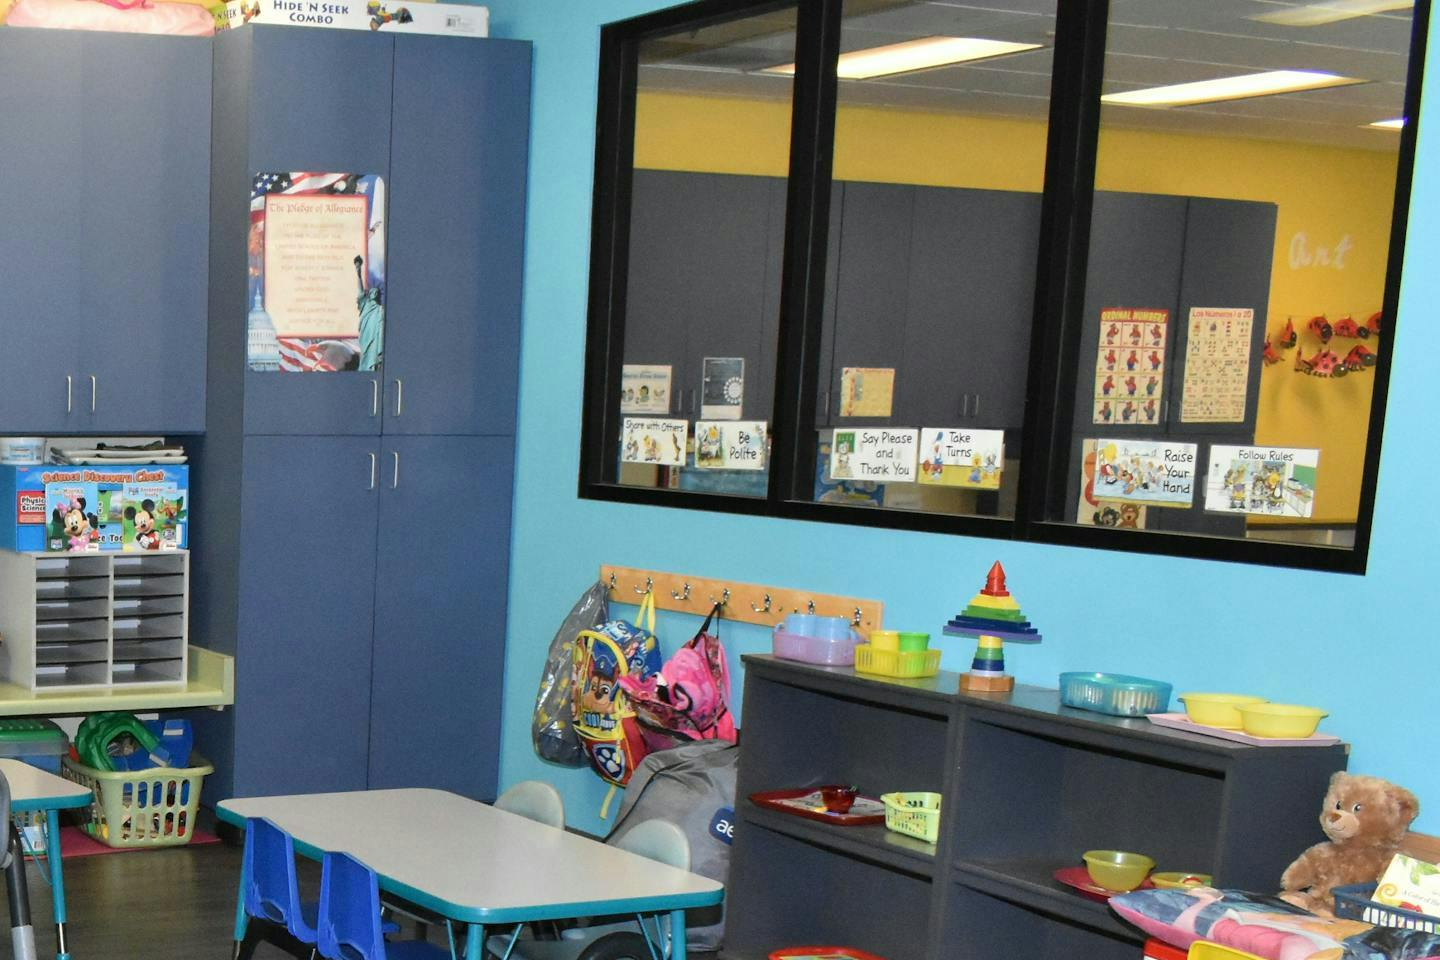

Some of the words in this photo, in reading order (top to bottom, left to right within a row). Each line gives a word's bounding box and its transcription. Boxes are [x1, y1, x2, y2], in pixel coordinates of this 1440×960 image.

[223, 7, 237, 19] SEEK
[273, 0, 303, 11] HIDE
[322, 3, 350, 14] SEEK
[289, 12, 334, 25] COMBO
[269, 203, 285, 214] The
[287, 202, 314, 215] Pledge
[315, 202, 323, 214] of
[625, 419, 645, 432] Share
[646, 421, 660, 431] with
[661, 422, 685, 433] Others
[738, 430, 751, 445] Be
[862, 432, 879, 446] Say
[881, 431, 913, 444] Please
[949, 431, 971, 443] Take
[729, 445, 757, 461] Polite
[876, 447, 894, 459] and
[946, 445, 973, 459] Turns
[1164, 449, 1194, 463] Raise
[1238, 449, 1267, 460] Follow
[1269, 449, 1294, 462] Rules
[860, 462, 890, 475] Thank
[892, 463, 910, 475] You
[1164, 464, 1190, 479] Your
[42, 471, 81, 483] Science
[83, 470, 134, 484] Discovery
[136, 469, 165, 483] Chest
[1162, 481, 1190, 495] Hand
